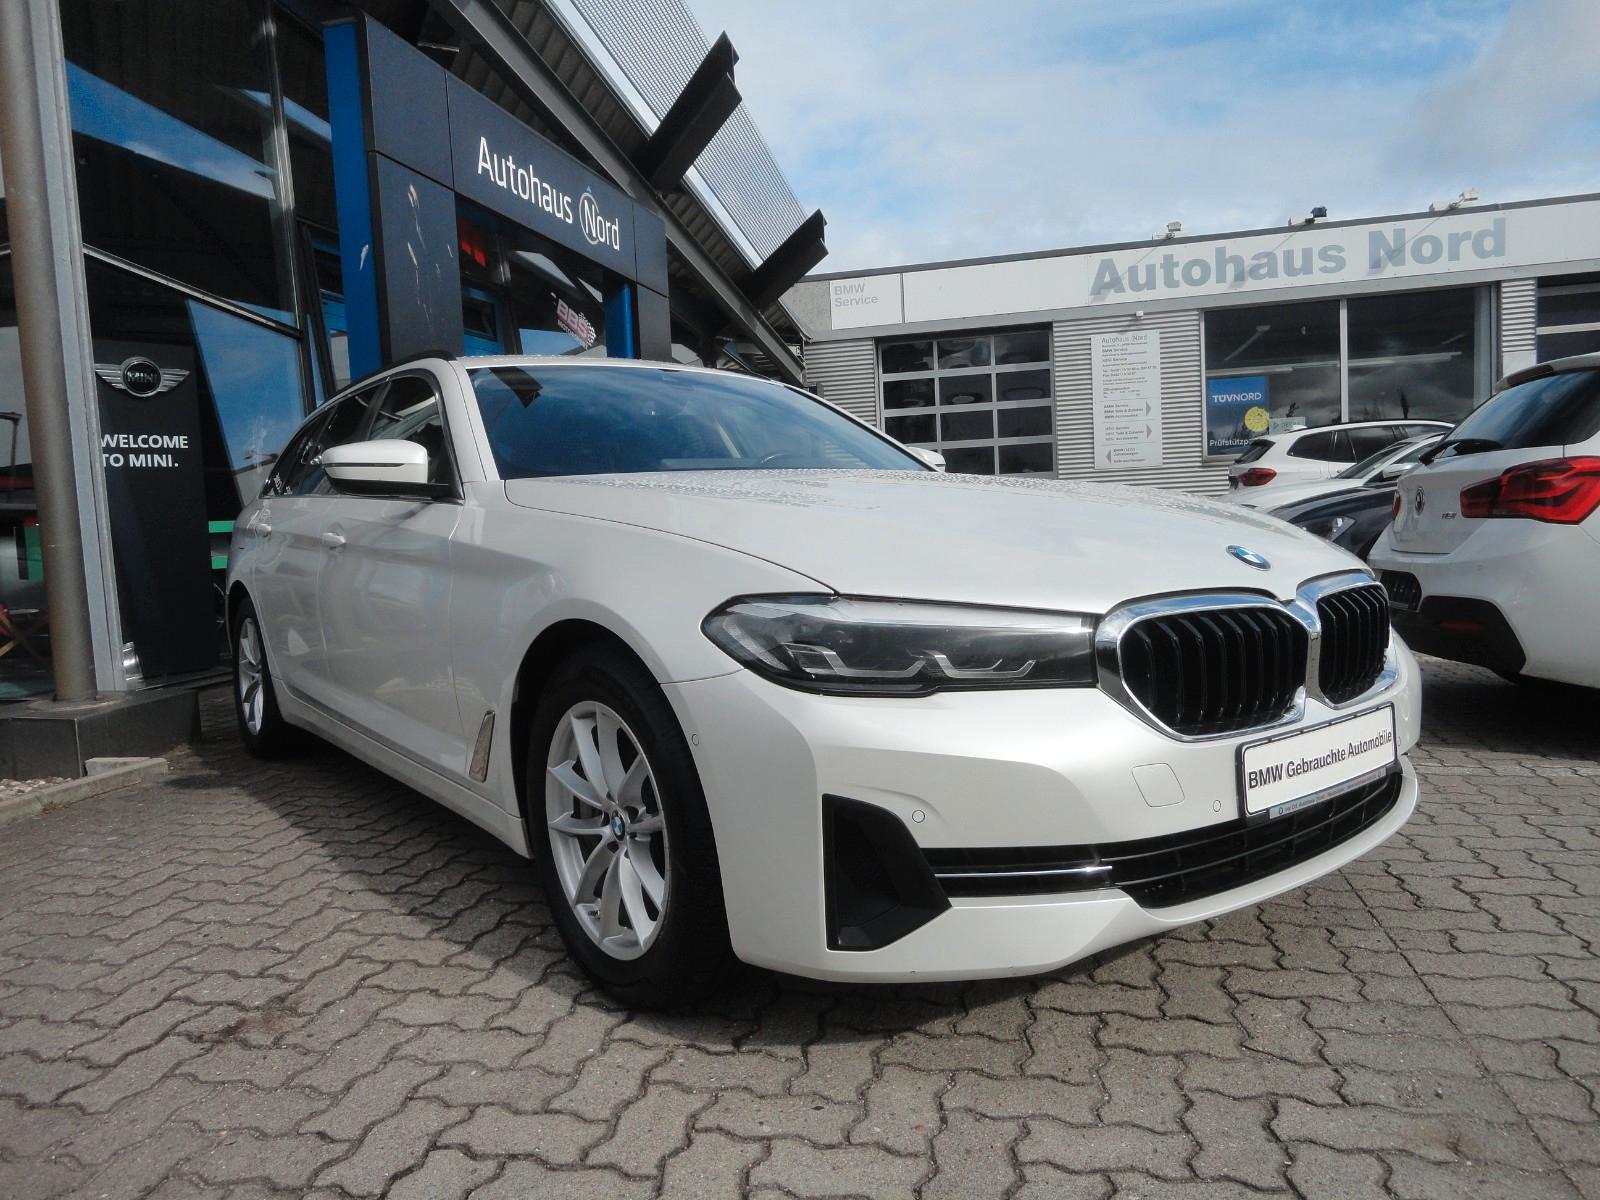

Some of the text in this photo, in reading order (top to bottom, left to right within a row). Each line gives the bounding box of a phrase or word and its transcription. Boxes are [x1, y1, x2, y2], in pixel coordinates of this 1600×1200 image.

[477, 136, 620, 251] Autohaus Nord
[1090, 217, 1507, 295] Autohaus Nord
[834, 282, 865, 296] BMW
[834, 295, 880, 307] Service
[127, 370, 157, 382] MINI
[101, 433, 189, 449] WELCOME
[1209, 438, 1250, 447] Prüfstützp
[102, 453, 179, 468] TO MINI.
[1248, 730, 1392, 789] BMW Gebrauchte Automobile
